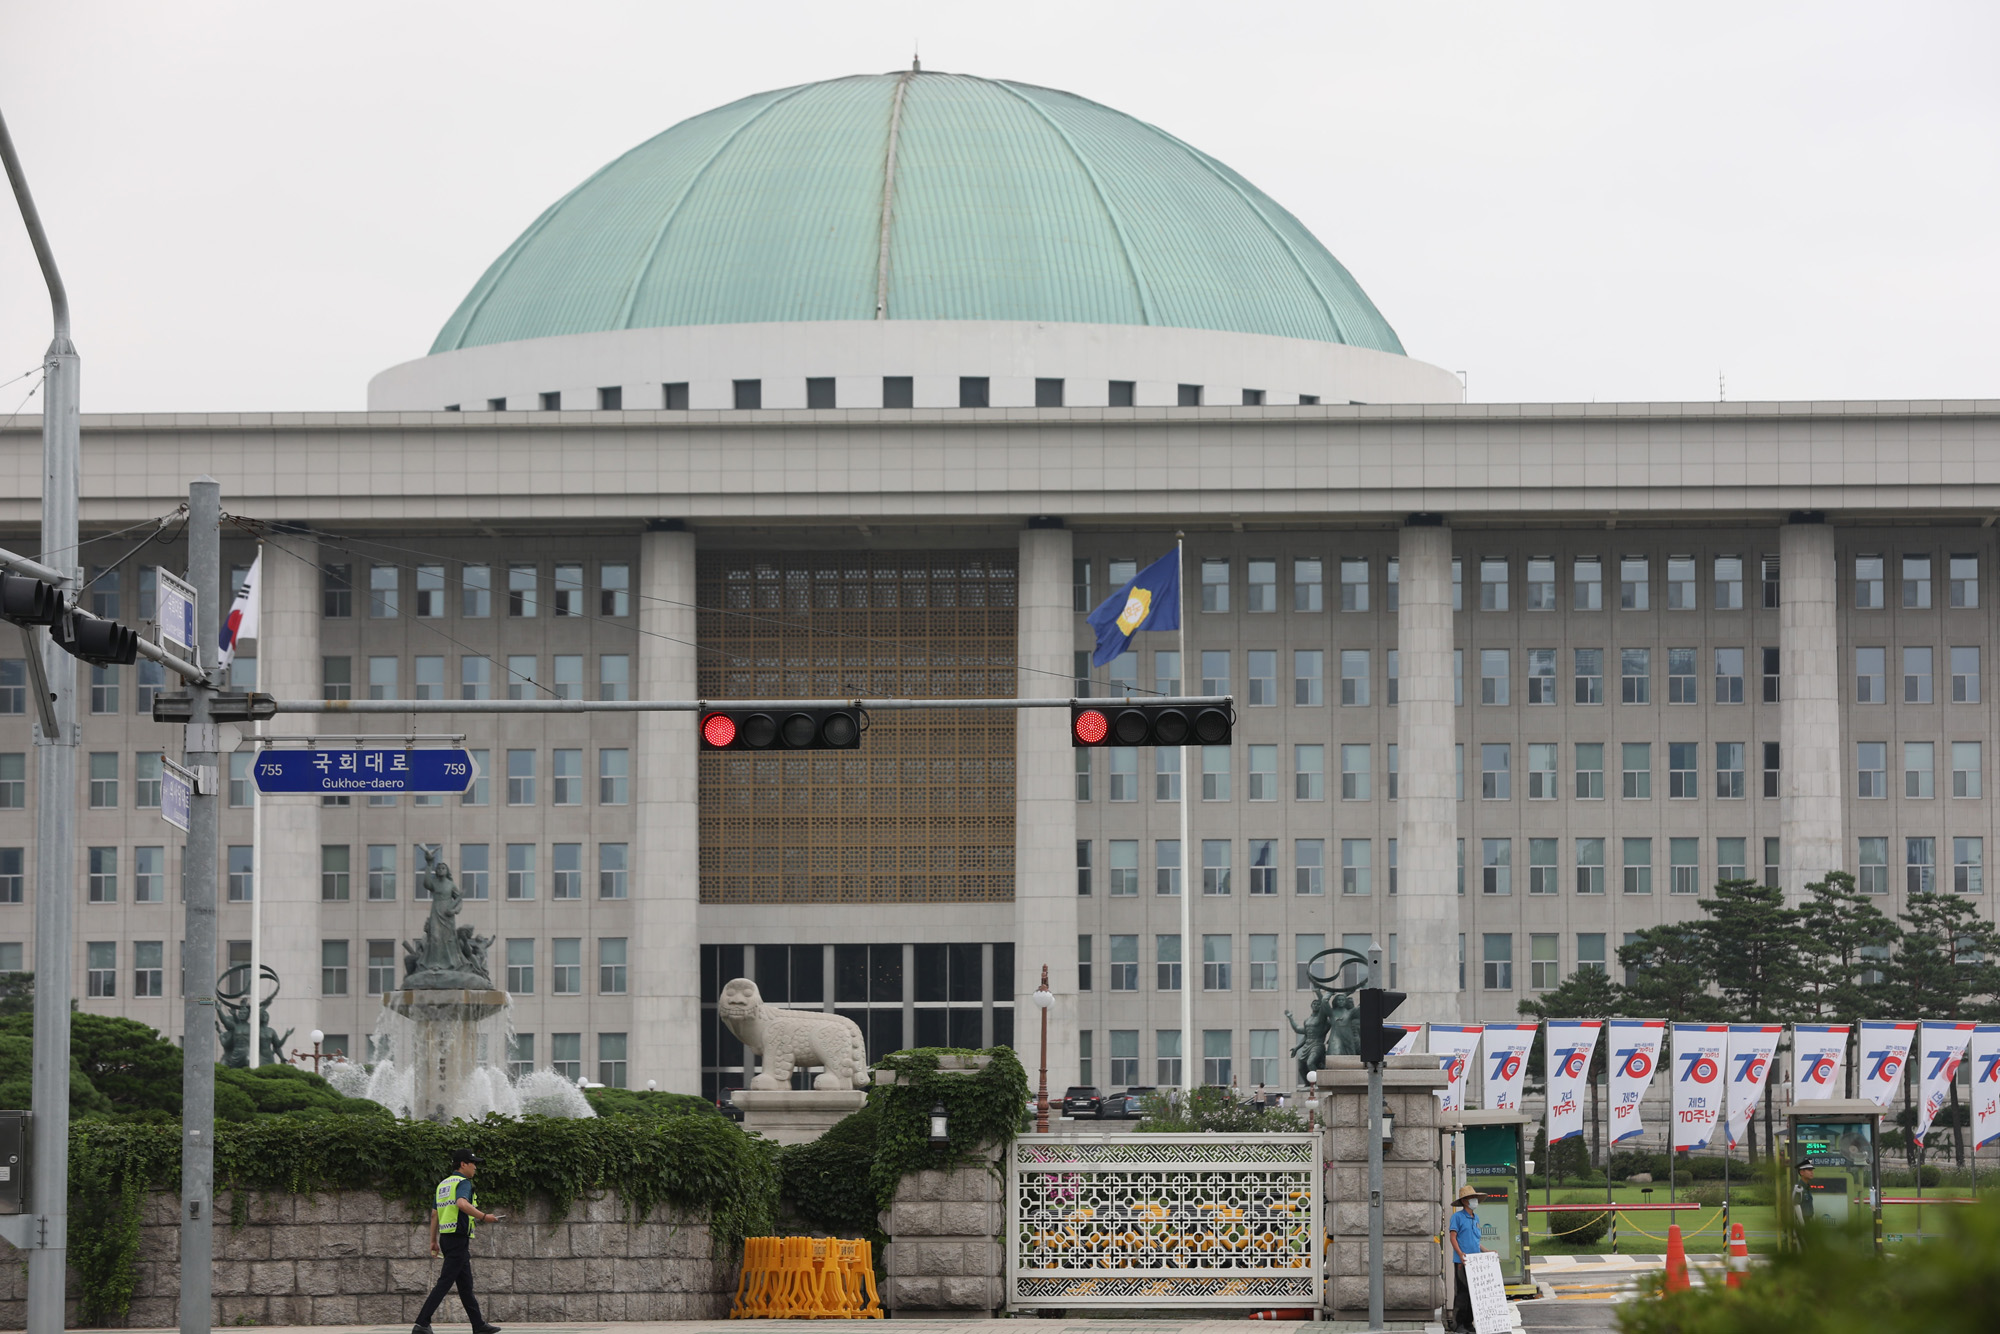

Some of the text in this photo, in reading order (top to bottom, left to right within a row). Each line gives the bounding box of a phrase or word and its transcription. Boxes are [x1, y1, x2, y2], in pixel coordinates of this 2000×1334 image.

[260, 763, 283, 777] 755
[312, 752, 410, 774] 국회대로
[443, 763, 466, 776] 759
[322, 777, 404, 789] Gukhoe-daero
[1614, 1047, 1652, 1079] 70
[1679, 1052, 1718, 1084] 70
[1688, 1097, 1706, 1108] 제헌
[1678, 1109, 1716, 1123] 70주년
